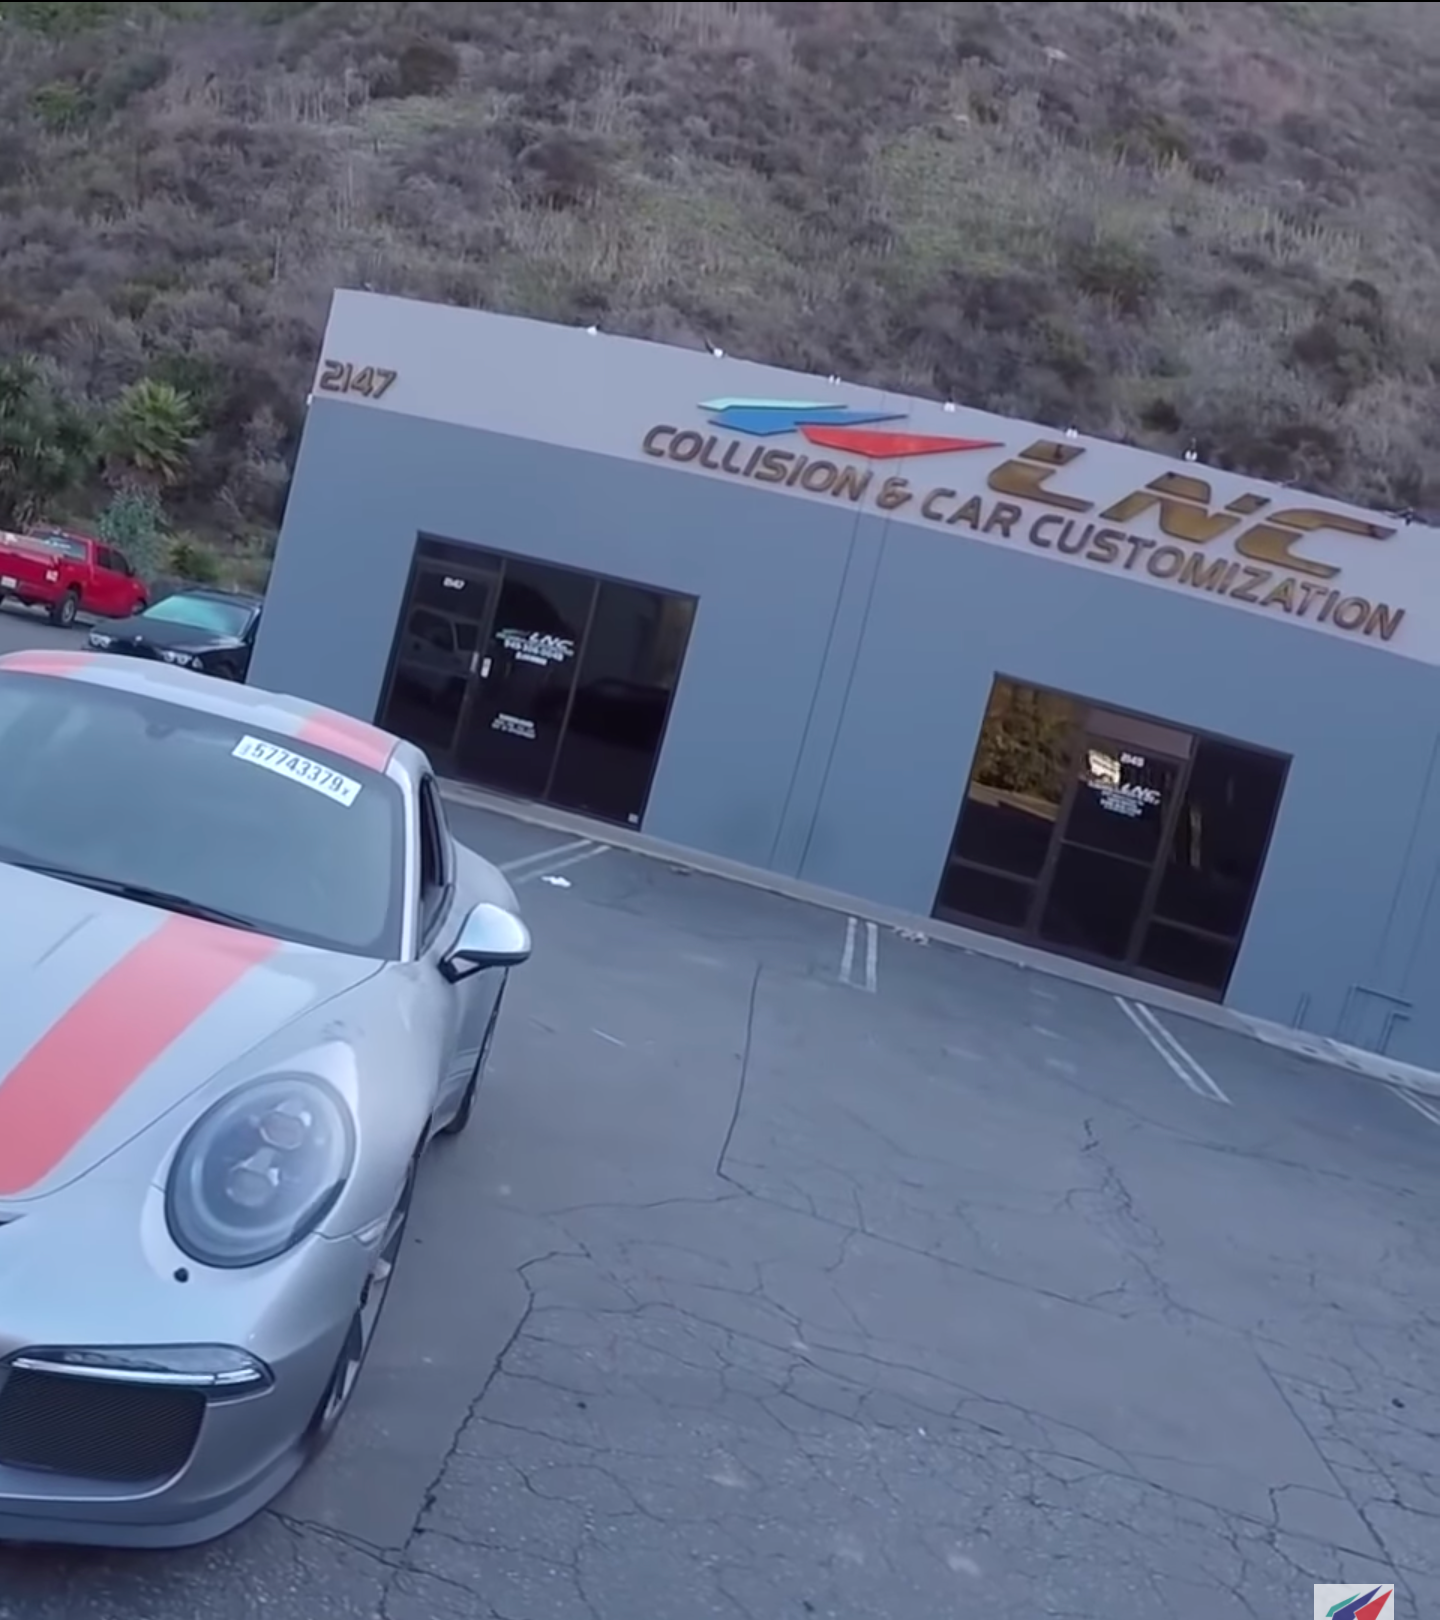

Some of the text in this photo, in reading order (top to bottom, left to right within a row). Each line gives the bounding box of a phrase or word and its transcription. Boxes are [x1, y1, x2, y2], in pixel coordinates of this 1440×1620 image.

[320, 359, 397, 399] 2147
[642, 425, 1406, 641] COLLISION & CAR CUSTOMIZATION
[988, 440, 1398, 579] LNC
[250, 742, 344, 792] 57743379
